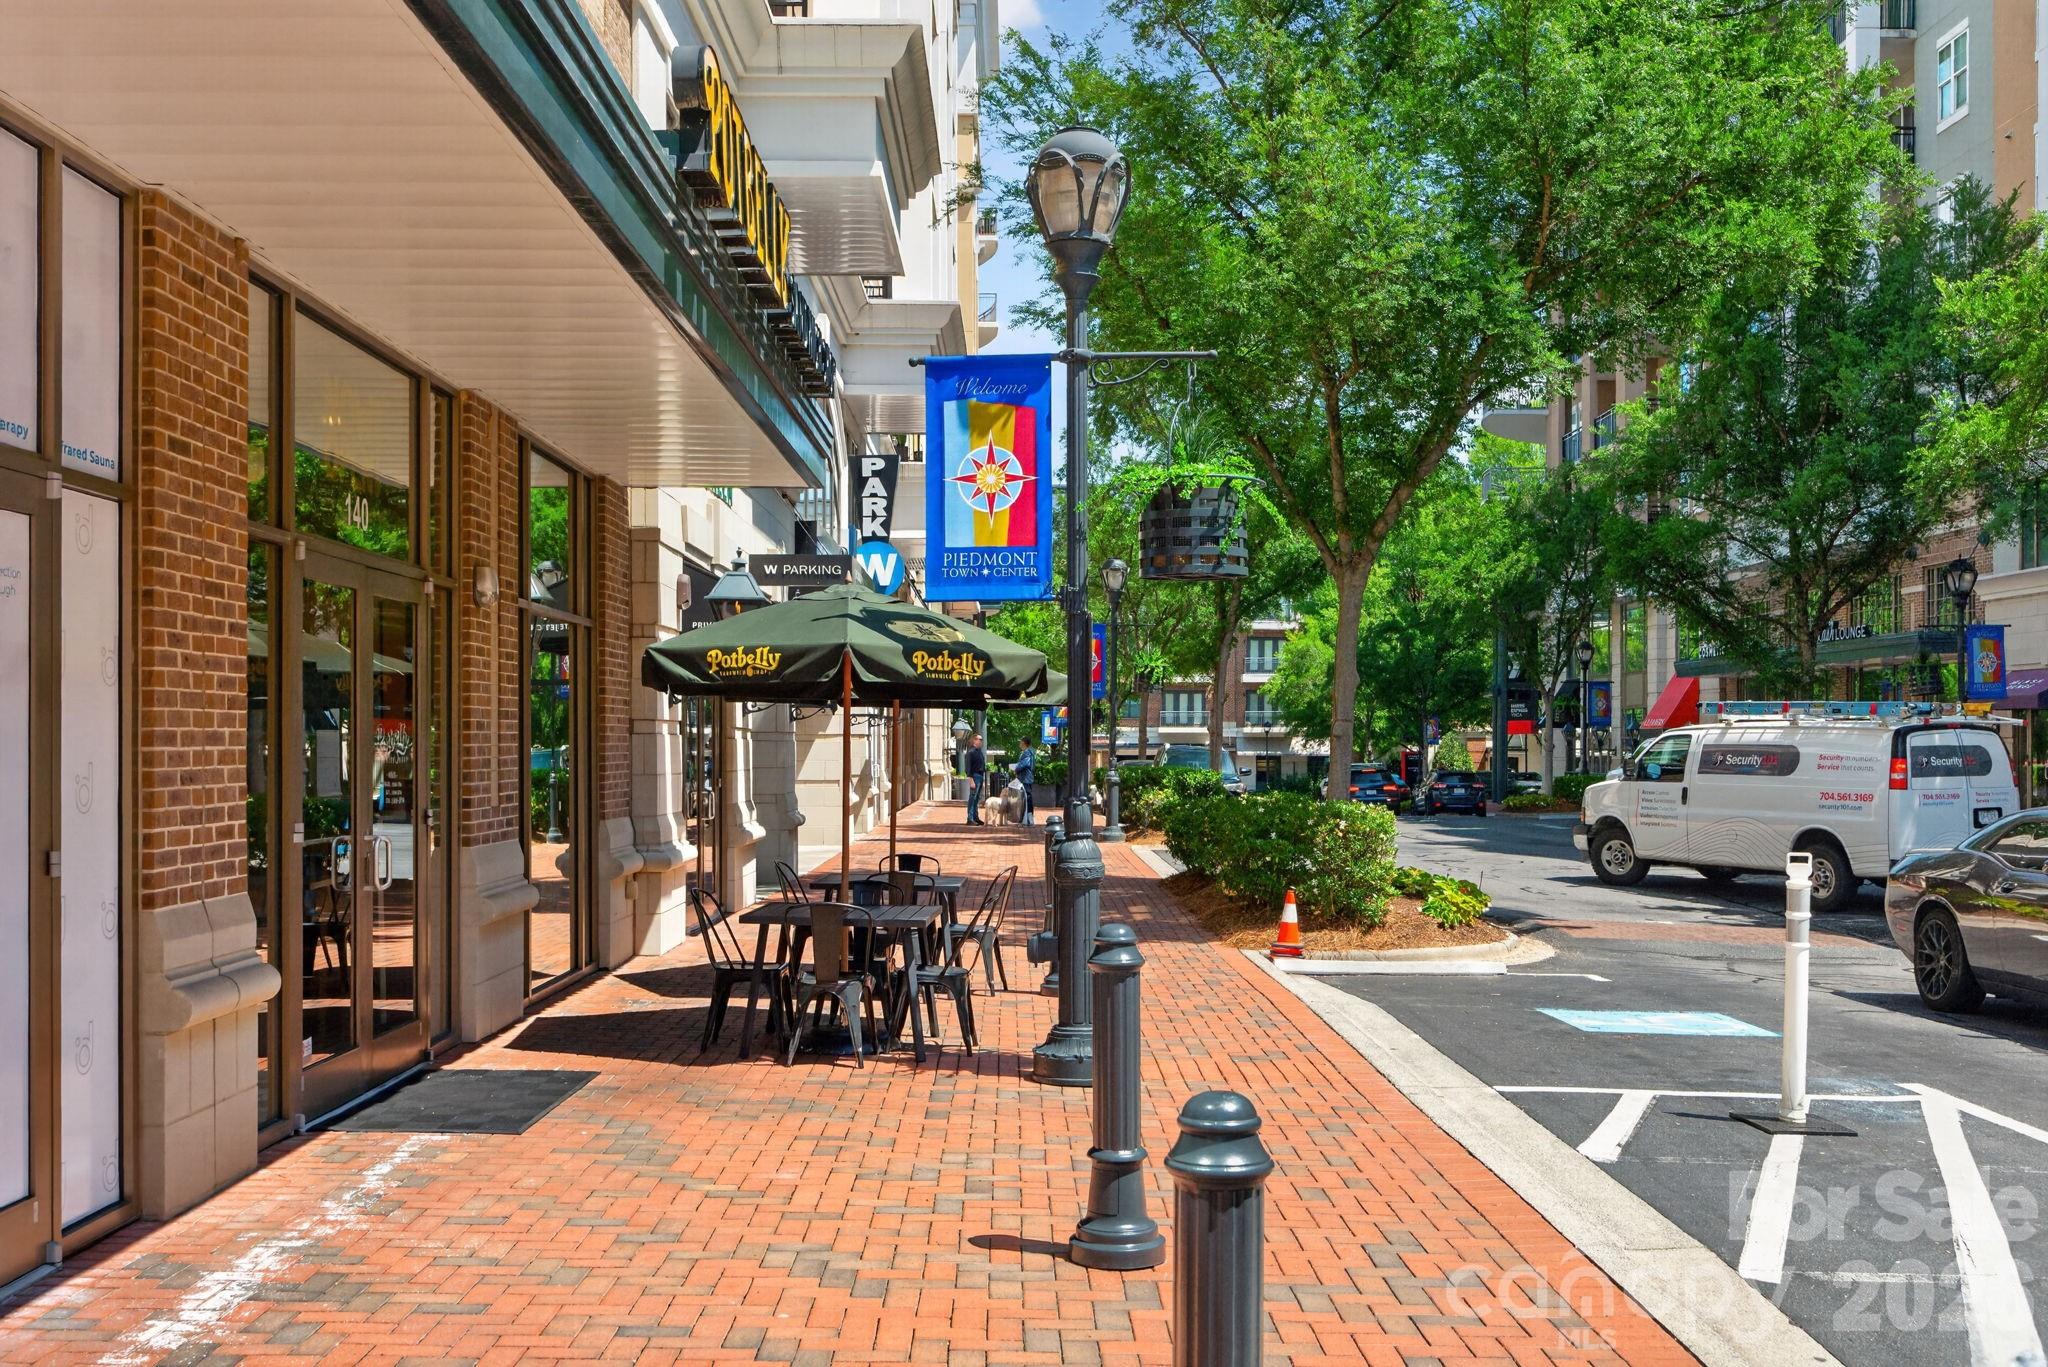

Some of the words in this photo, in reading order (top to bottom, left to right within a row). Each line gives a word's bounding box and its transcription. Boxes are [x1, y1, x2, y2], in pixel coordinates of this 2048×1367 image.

[955, 376, 1028, 395] Welcome
[90, 451, 116, 469] Sauna
[861, 457, 888, 537] PARK
[345, 492, 369, 531] 140
[943, 551, 1038, 567] PIEDMONT
[764, 564, 778, 575] W
[783, 564, 842, 575] PARKING
[857, 553, 898, 586] W
[942, 567, 979, 578] TOWN
[993, 566, 1038, 577] CENTER
[1835, 624, 1866, 641] LOUNGE
[706, 645, 782, 677] Potbelly
[912, 650, 986, 681] Potbelly
[1818, 754, 1844, 762] Security
[1817, 763, 1840, 771] Service
[1819, 791, 1874, 802] 704.561.3169
